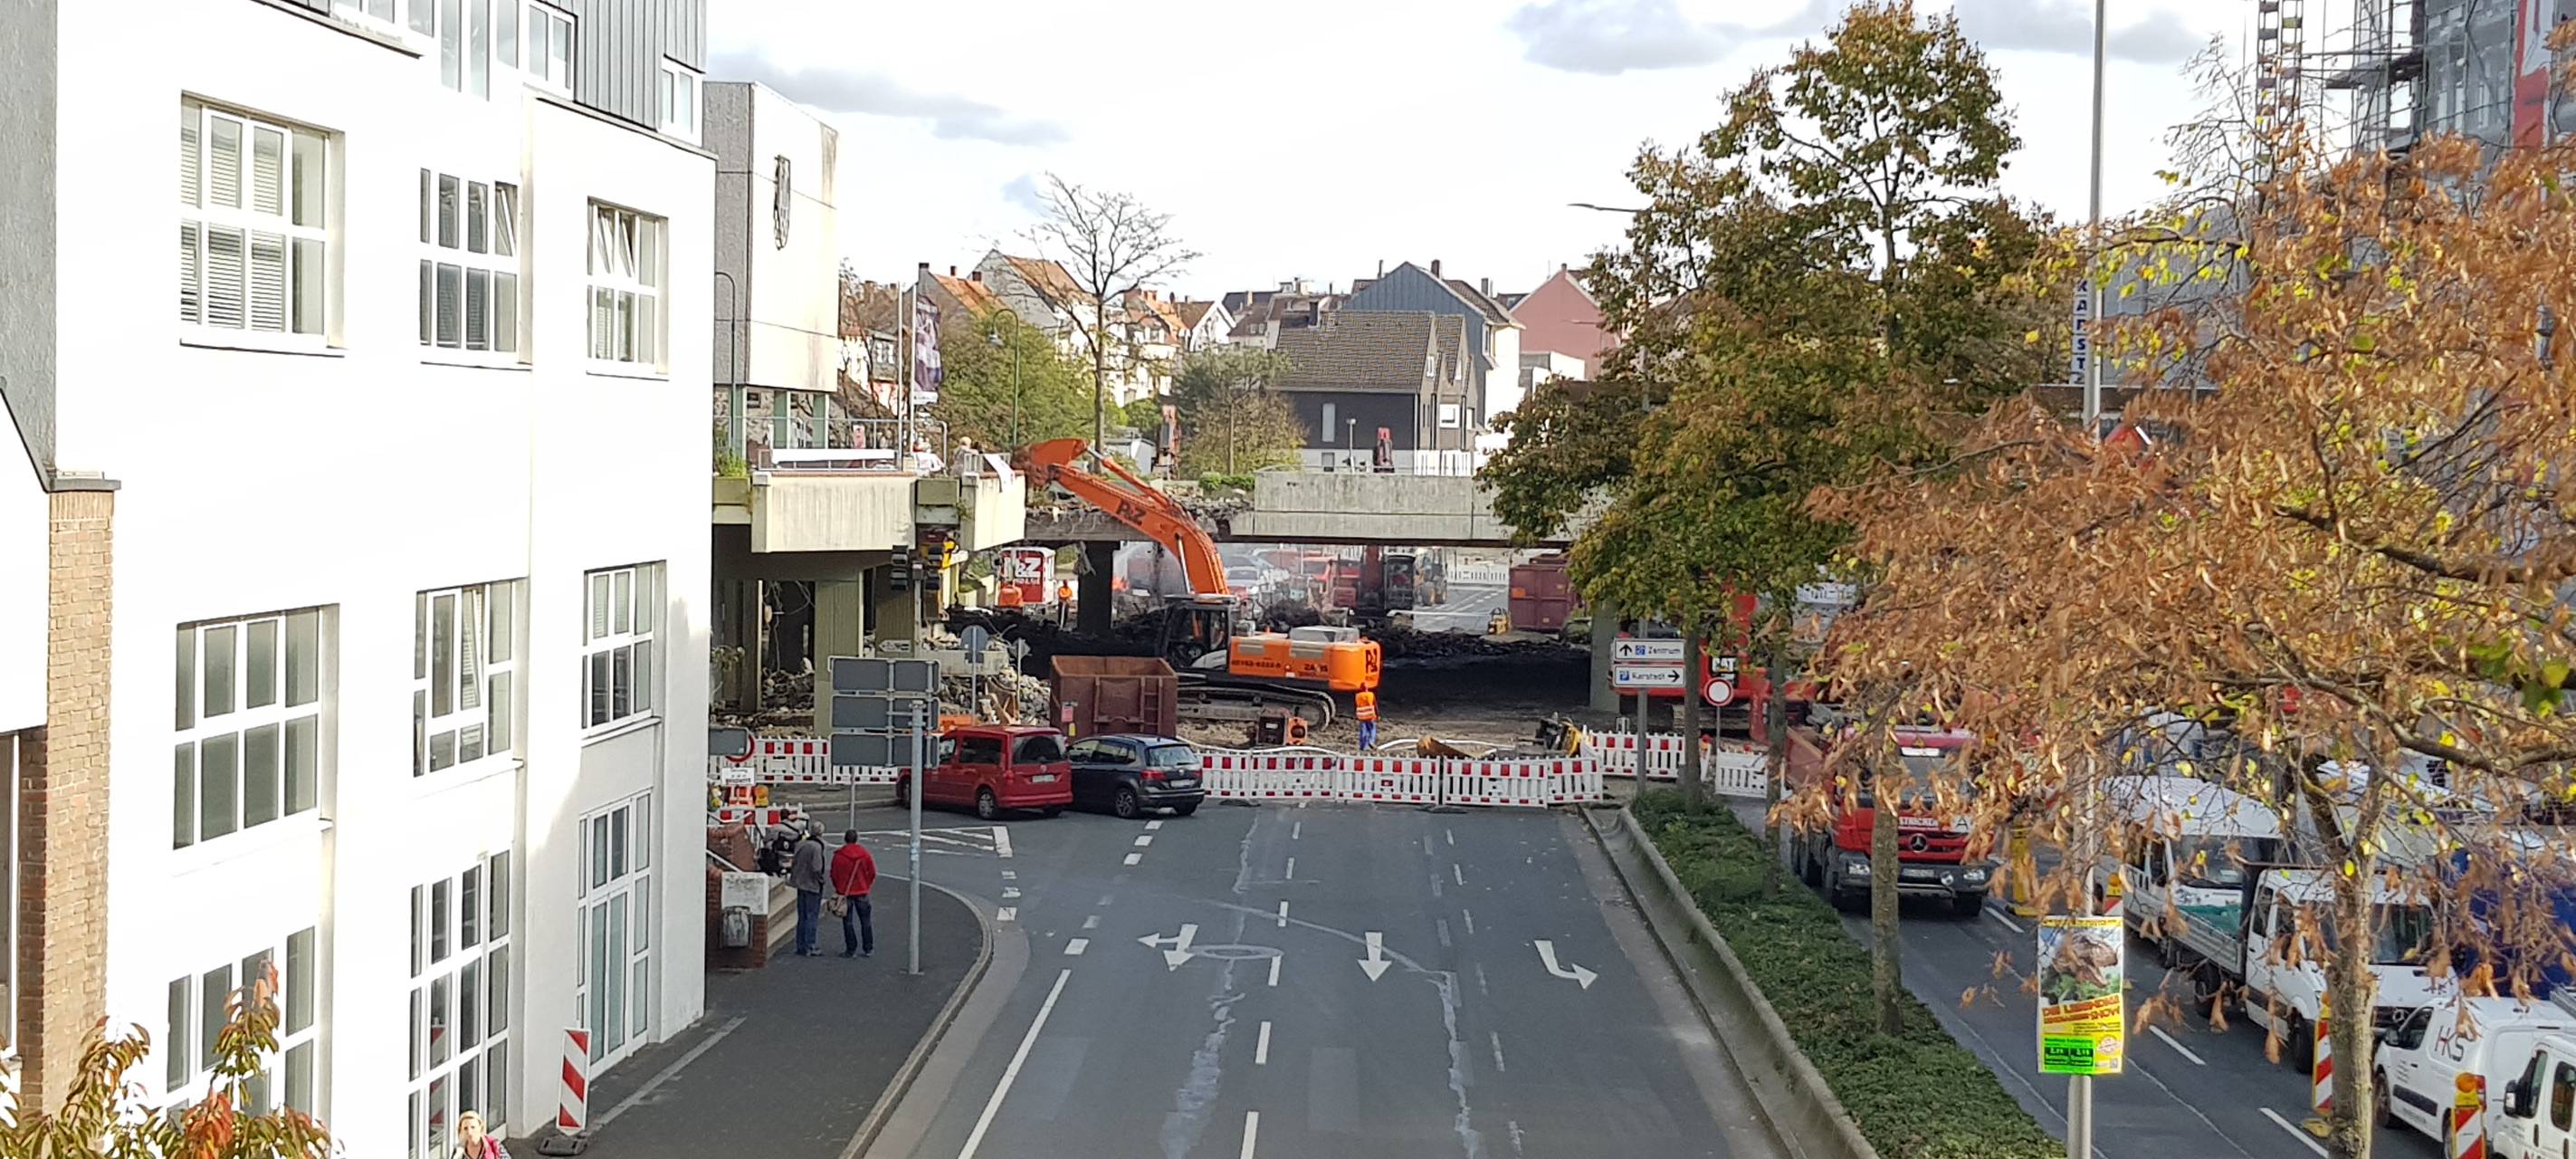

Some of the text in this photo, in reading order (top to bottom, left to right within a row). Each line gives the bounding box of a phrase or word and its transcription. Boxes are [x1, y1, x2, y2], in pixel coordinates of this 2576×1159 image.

[1712, 657, 1736, 672] CAT
[1955, 816, 1969, 830] A
[2435, 1024, 2478, 1062] HKS
